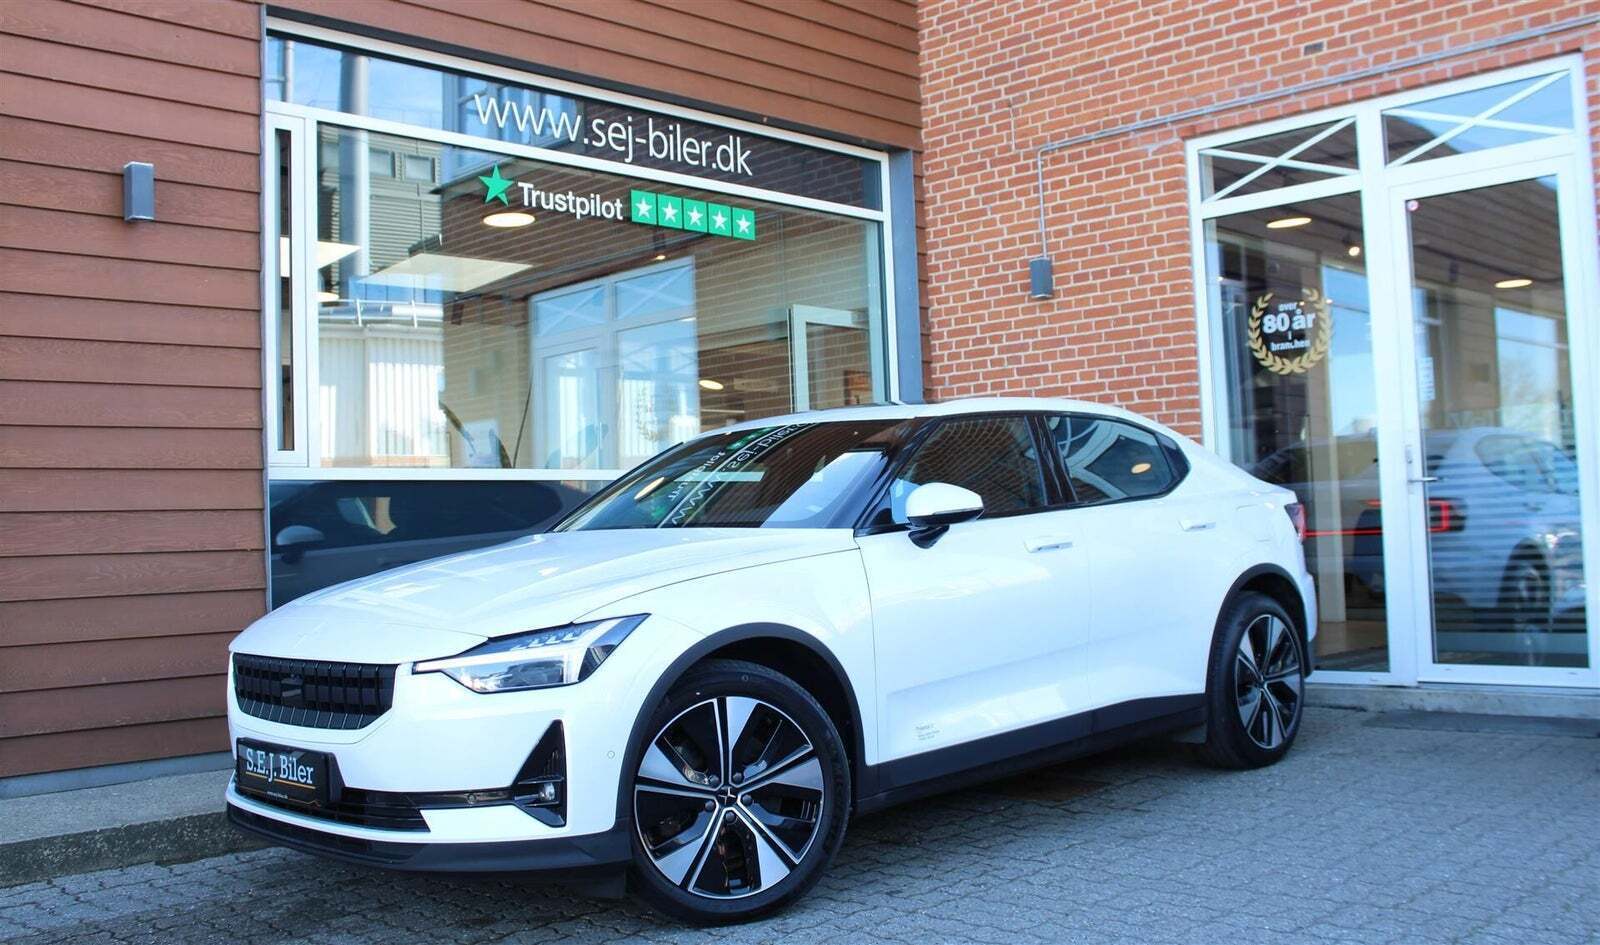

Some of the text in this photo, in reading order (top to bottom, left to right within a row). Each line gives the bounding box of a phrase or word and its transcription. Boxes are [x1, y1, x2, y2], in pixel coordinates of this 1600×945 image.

[474, 94, 753, 176] www.sej-biler.dk
[518, 181, 624, 221] Trustpilot
[1263, 308, 1316, 334] 80 år
[246, 748, 314, 785] S.E.J. Biler
